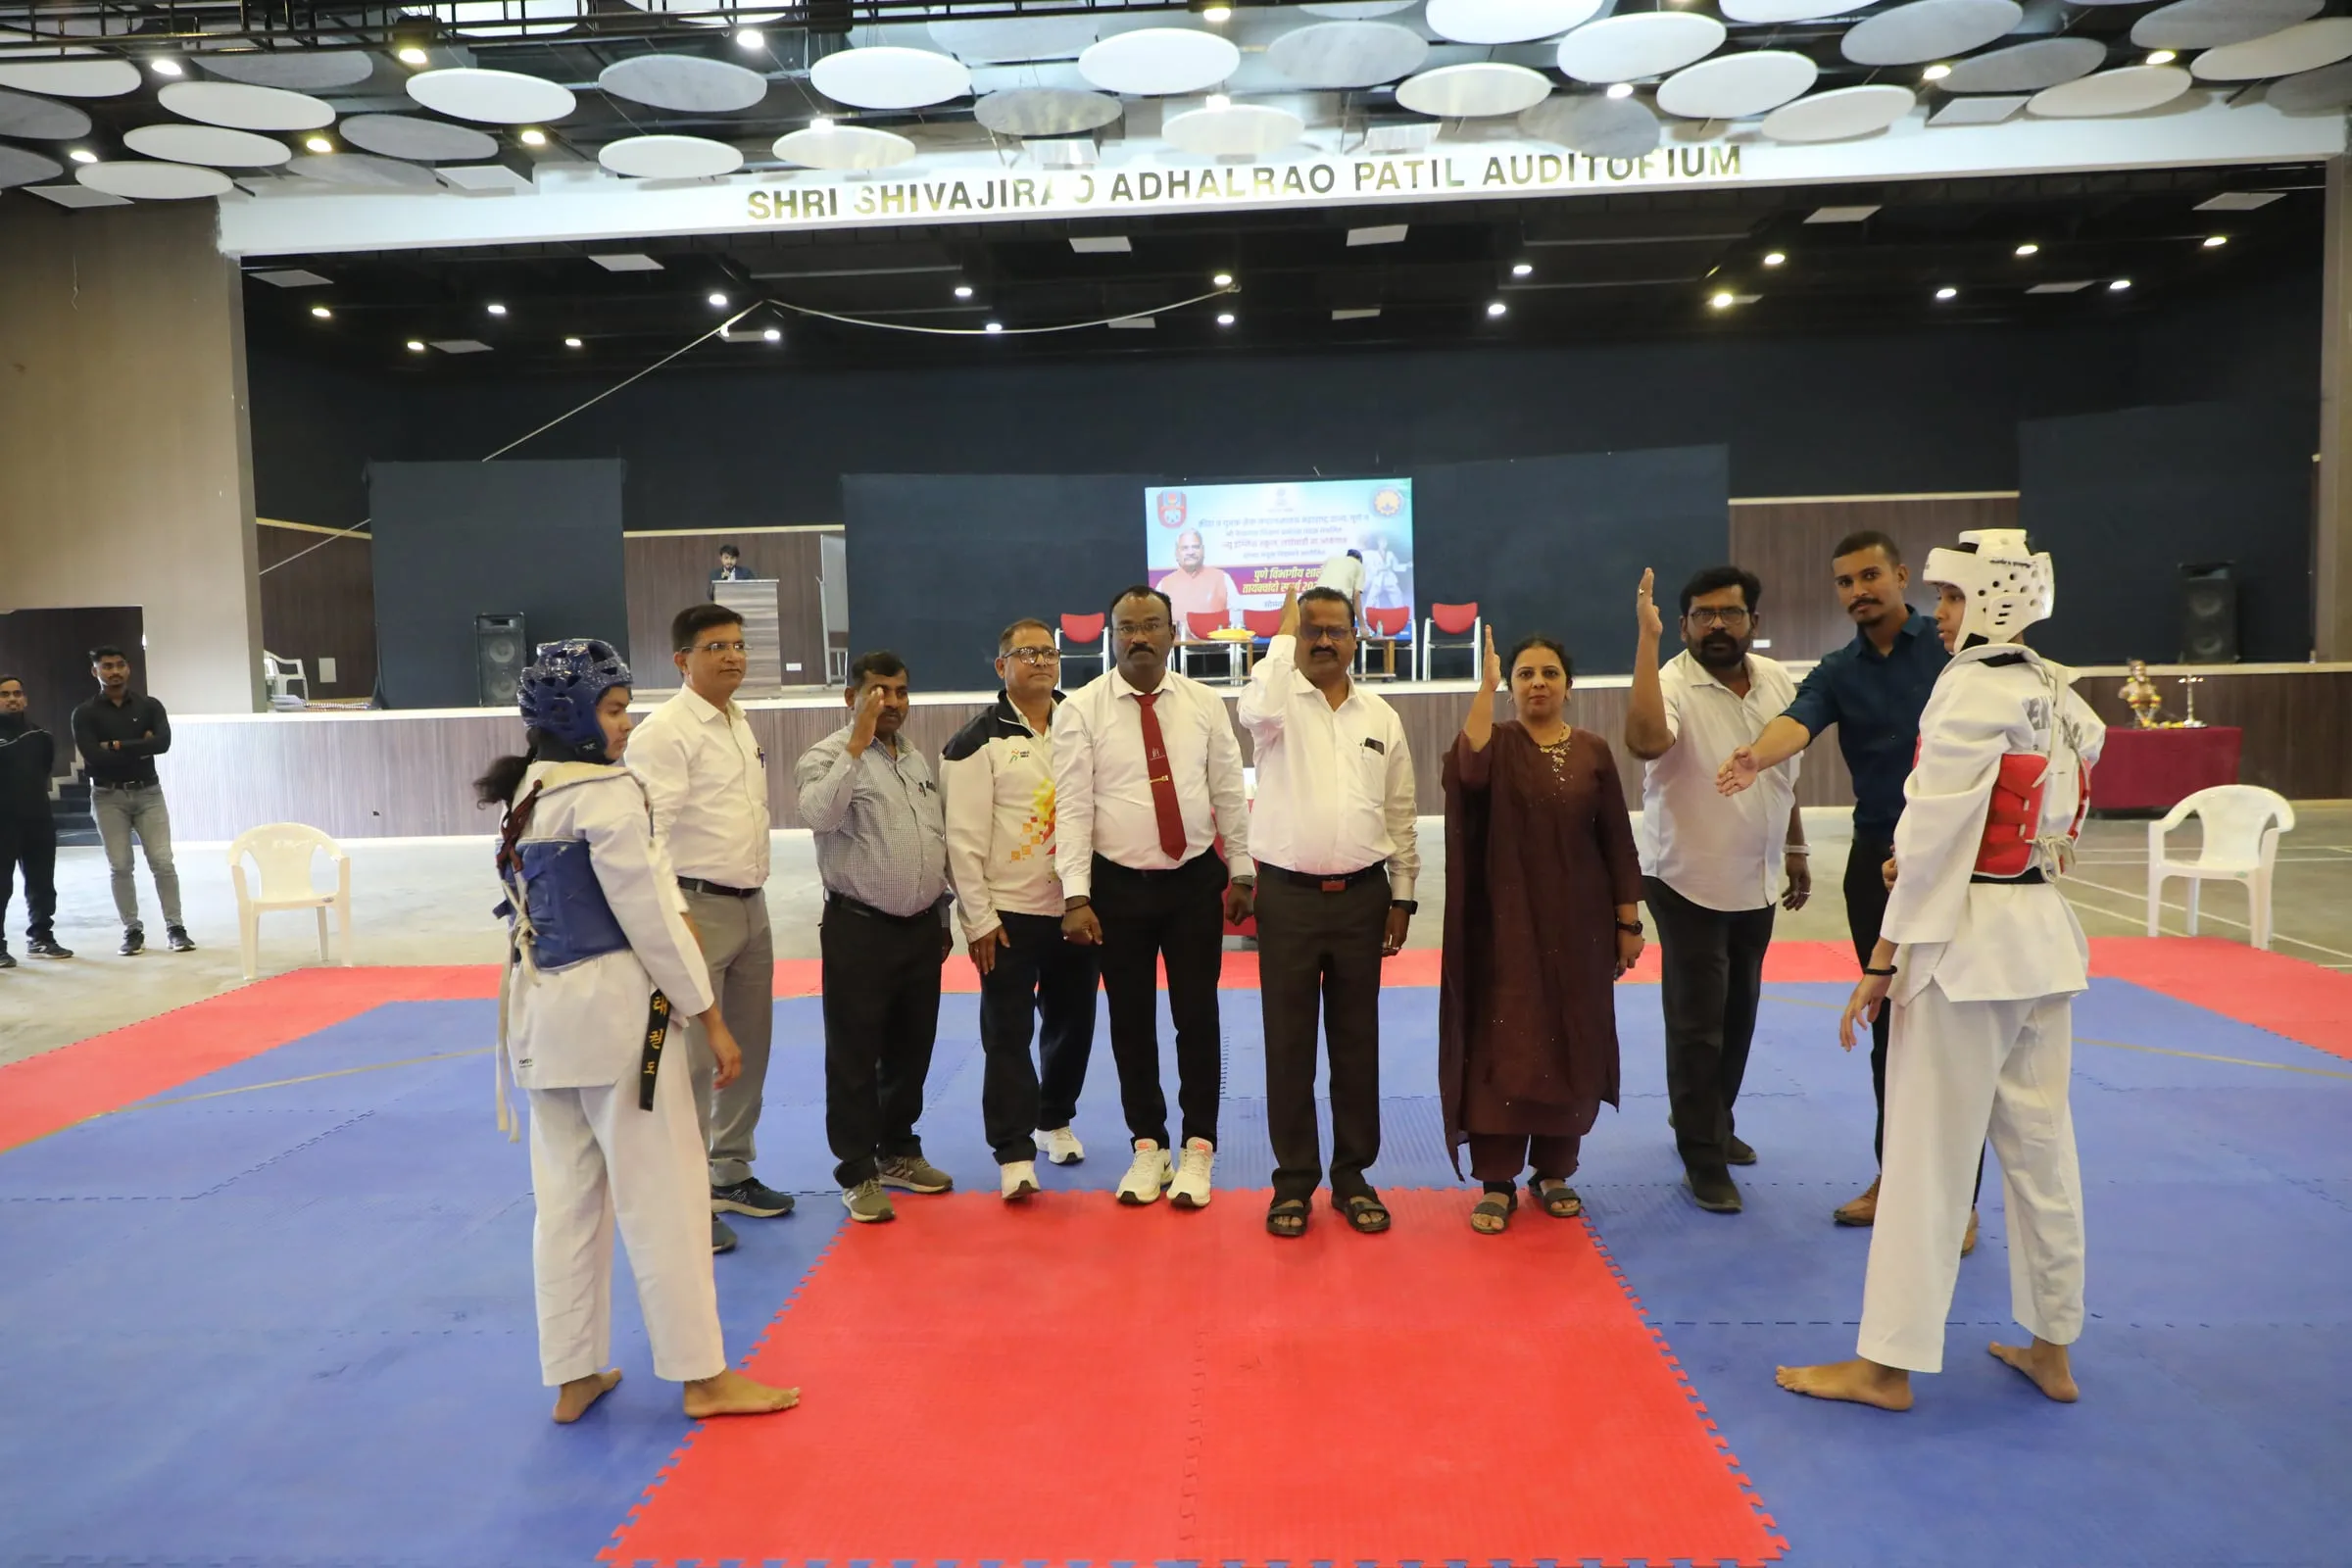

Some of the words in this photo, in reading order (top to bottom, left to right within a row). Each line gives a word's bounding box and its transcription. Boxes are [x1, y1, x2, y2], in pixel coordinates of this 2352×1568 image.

[747, 187, 838, 220] SHRI
[1109, 163, 1336, 202] ADHALRAO
[1354, 157, 1465, 191] PATIL
